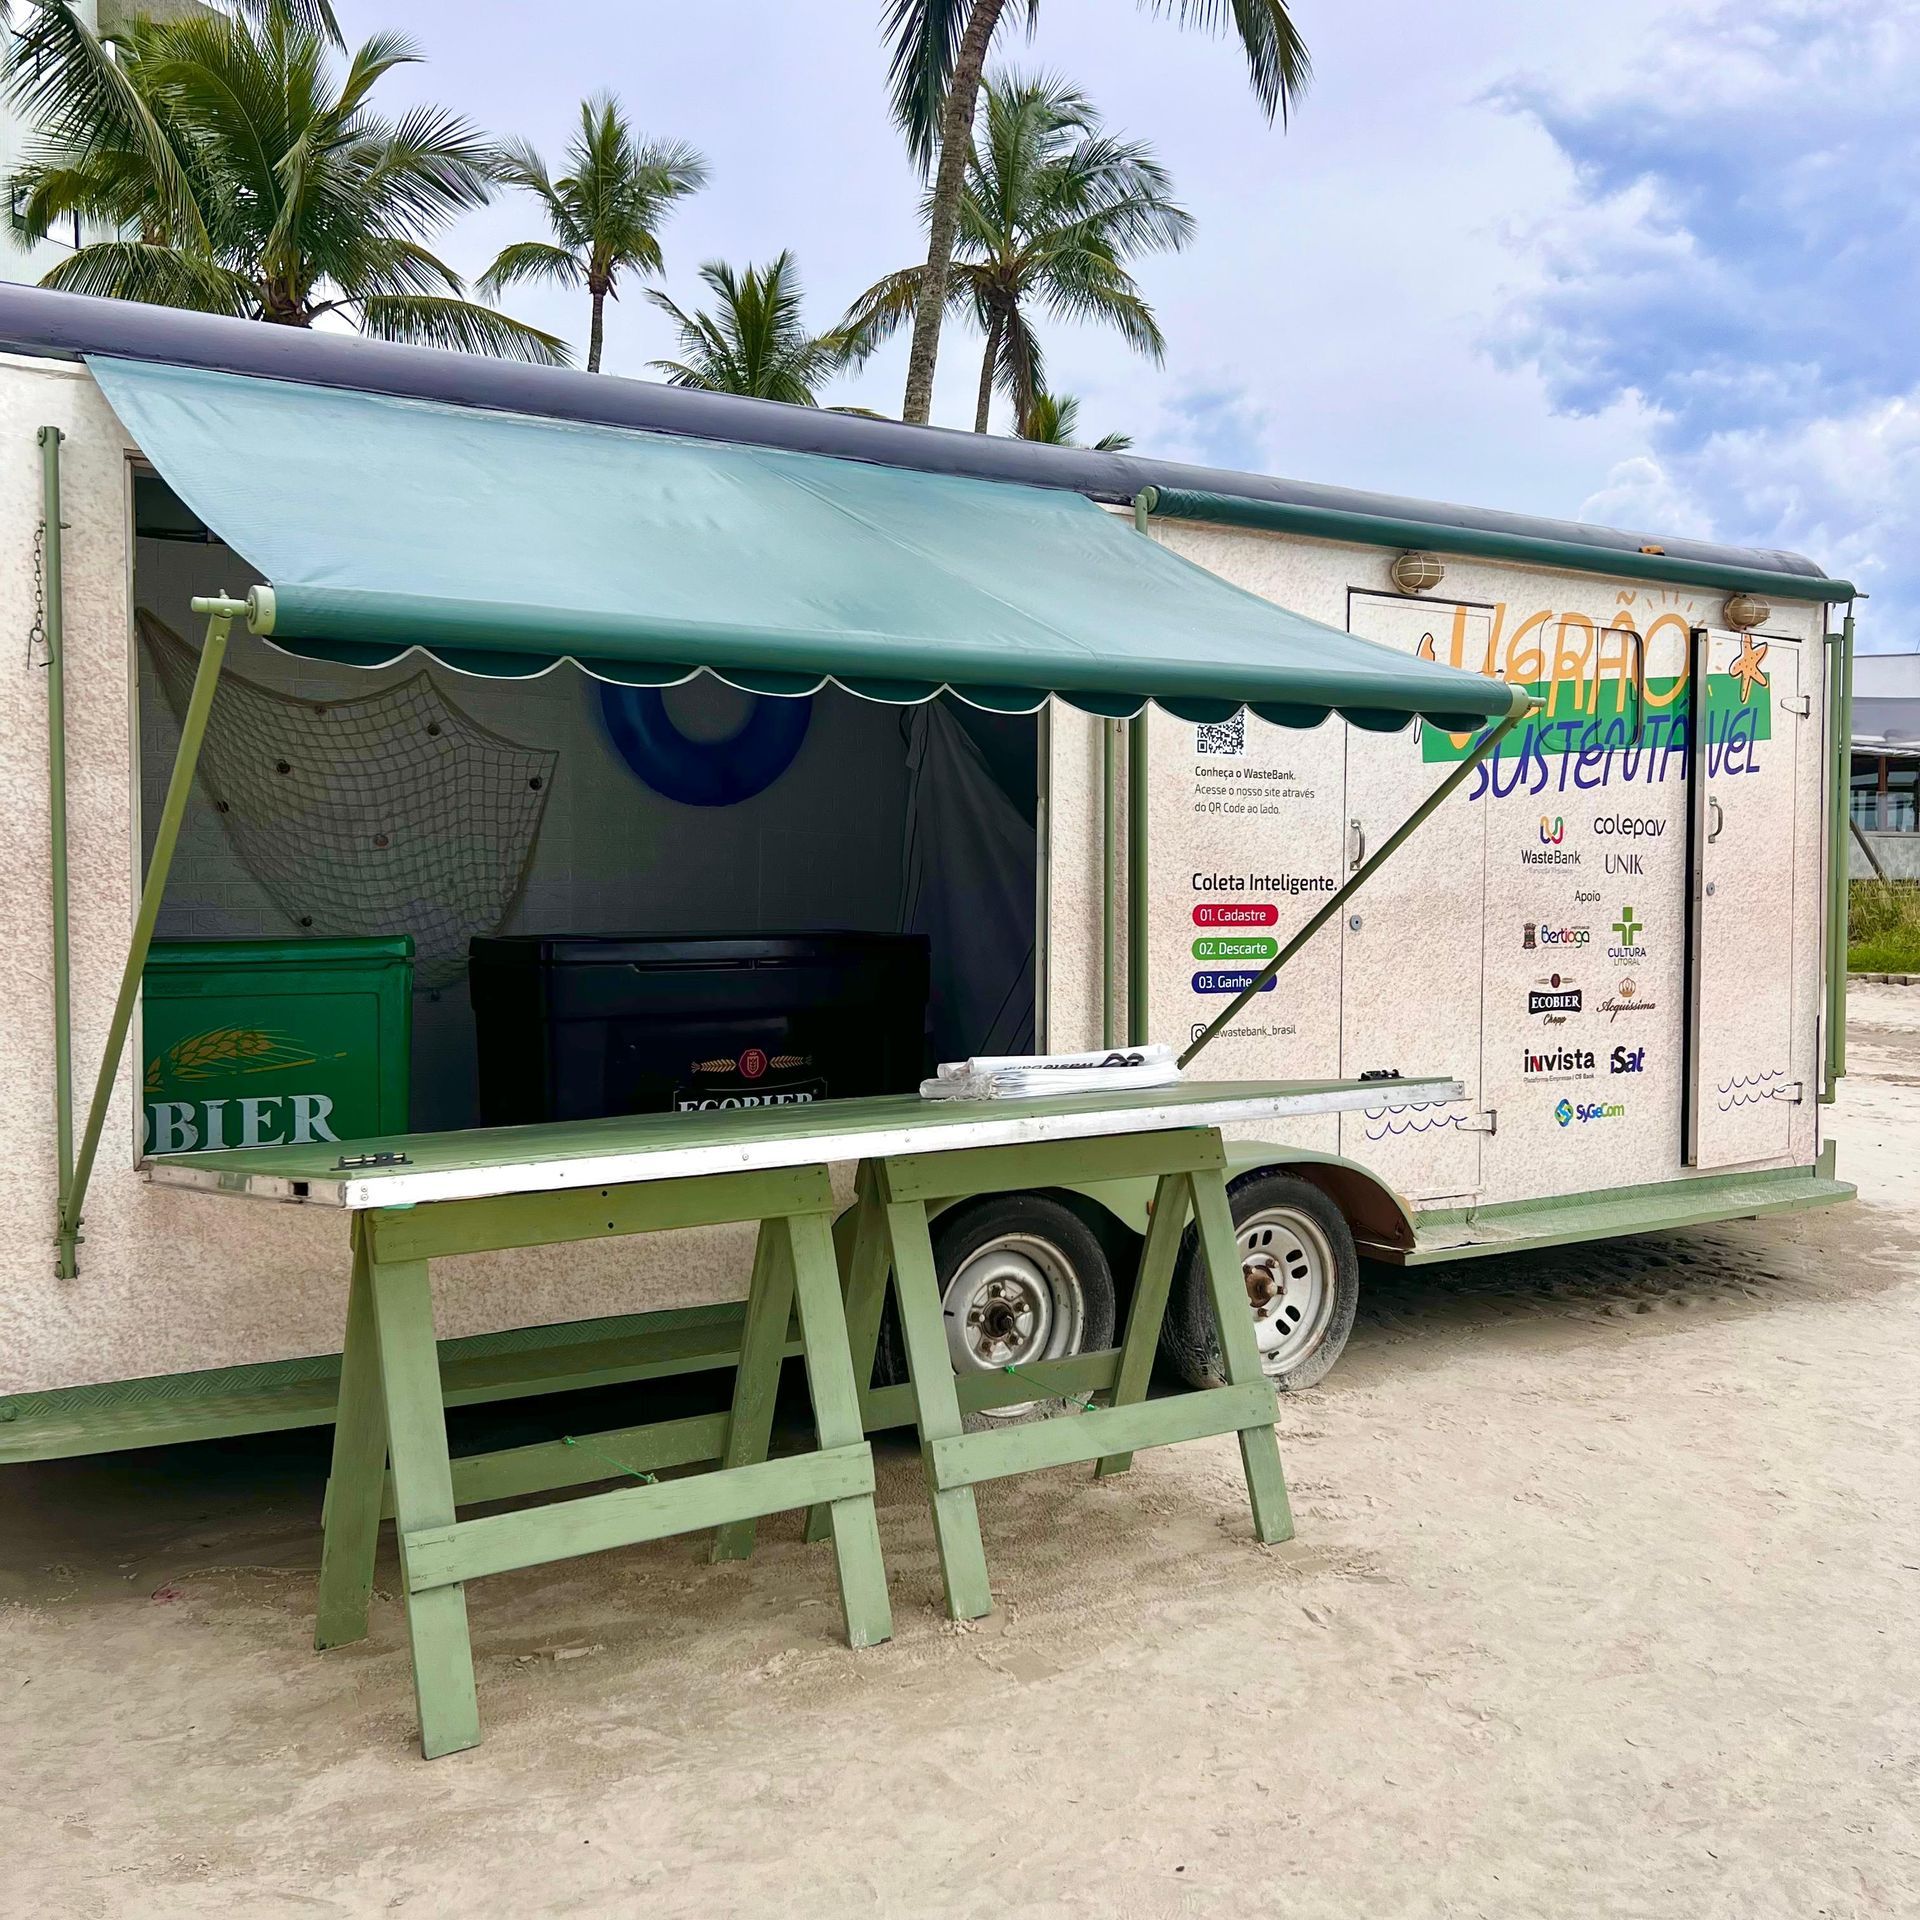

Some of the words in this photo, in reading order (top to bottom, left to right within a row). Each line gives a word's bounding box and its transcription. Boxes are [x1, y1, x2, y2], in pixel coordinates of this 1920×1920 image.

[1195, 766, 1234, 780] Conheça
[1236, 770, 1242, 778] o
[1244, 768, 1296, 780] WasteBank.
[1195, 784, 1227, 795] Acesse
[1229, 787, 1235, 795] o
[1236, 787, 1263, 796] nosso
[1265, 786, 1281, 797] site
[1282, 788, 1315, 799] através
[1195, 802, 1207, 812] do
[1208, 802, 1222, 814] QR
[1223, 803, 1246, 813] Code
[1247, 805, 1258, 814] ao
[1260, 804, 1281, 815] lado.
[1521, 850, 1581, 864] WasteBank
[1605, 854, 1643, 875] UNIK
[1192, 873, 1245, 891] Coleta
[1249, 874, 1338, 895] Inteligente.
[1574, 890, 1601, 904] Apoio
[1200, 909, 1215, 921] 01.
[1217, 909, 1266, 922] Cadastre
[1199, 942, 1216, 955] 02.
[1219, 942, 1268, 955] Descarte
[1607, 947, 1647, 958] CULTURA
[1614, 957, 1640, 966] LITORAL
[1198, 976, 1216, 988] 03.
[1217, 976, 1253, 989] Ganhe
[1531, 995, 1580, 1009] ECOBIER
[1610, 1046, 1645, 1074] iSat
[1576, 1103, 1624, 1122] SyGeCom
[143, 1094, 341, 1154] BIER
